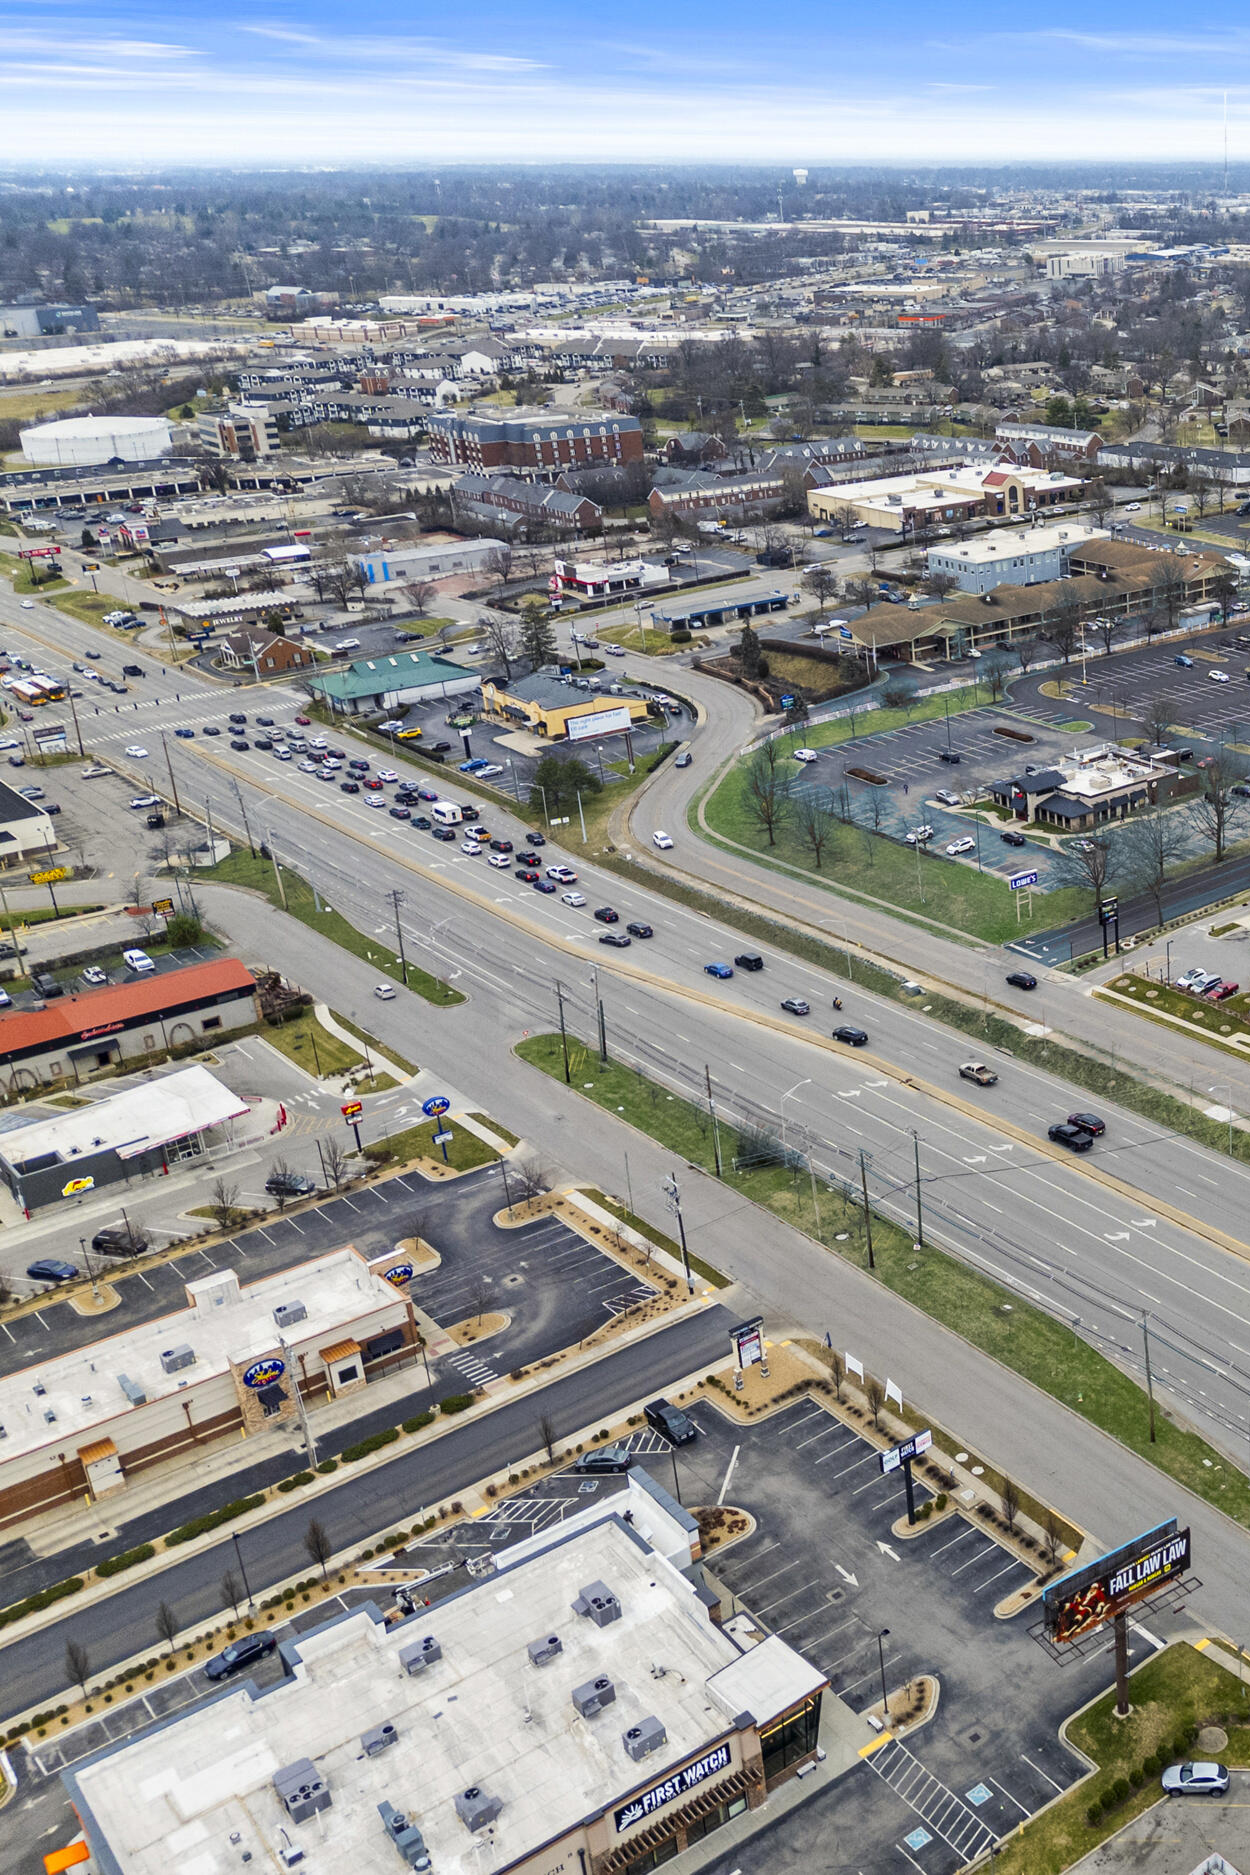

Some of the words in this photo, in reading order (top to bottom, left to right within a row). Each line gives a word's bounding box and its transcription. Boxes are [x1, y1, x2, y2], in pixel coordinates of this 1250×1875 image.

[212, 615, 244, 626] JEWELRY
[1012, 874, 1036, 889] LOWE'S
[1109, 1569, 1135, 1596] FALL
[1136, 1553, 1161, 1580] LAW
[1163, 1538, 1187, 1566] LAW
[642, 1775, 681, 1812] FIRST
[683, 1747, 727, 1781] WATCH
